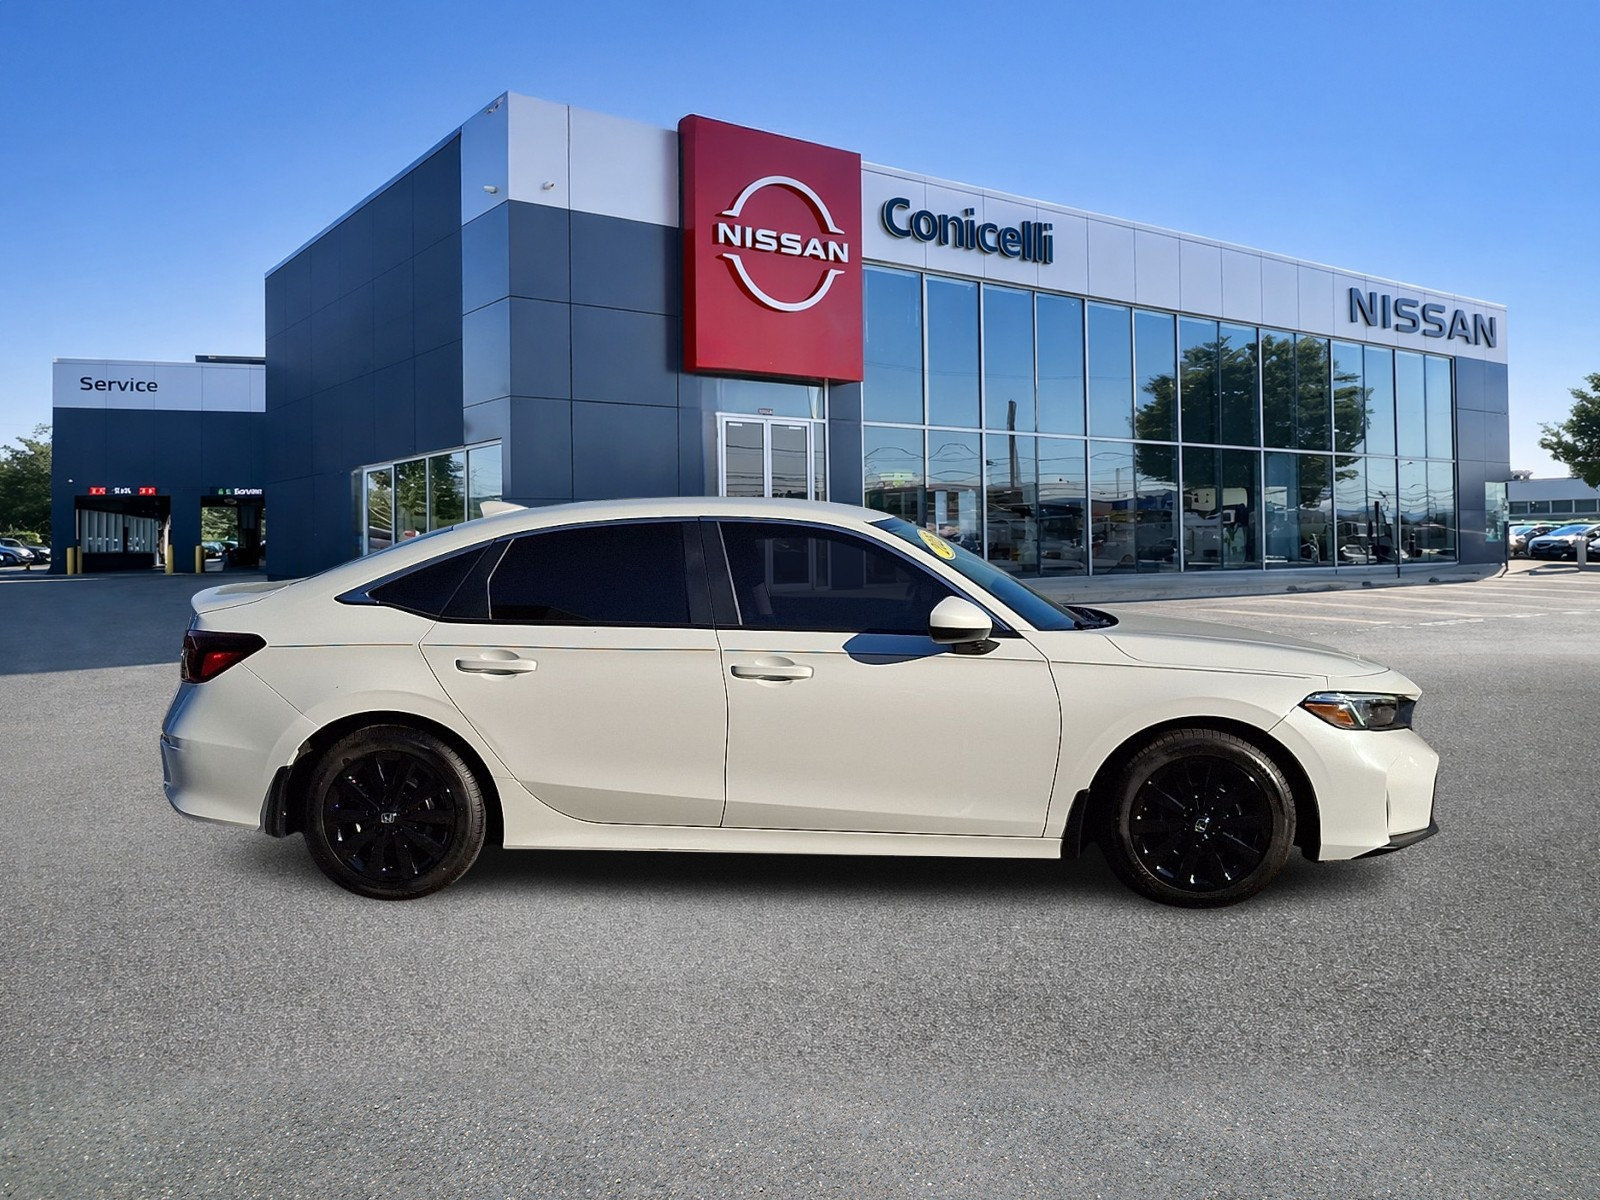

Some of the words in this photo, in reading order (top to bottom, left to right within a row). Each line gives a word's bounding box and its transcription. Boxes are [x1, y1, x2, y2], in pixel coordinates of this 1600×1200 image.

[717, 222, 849, 263] NISSAN
[881, 197, 1054, 264] Conicelli
[1349, 287, 1497, 348] NISSAN
[79, 376, 158, 392] Service
